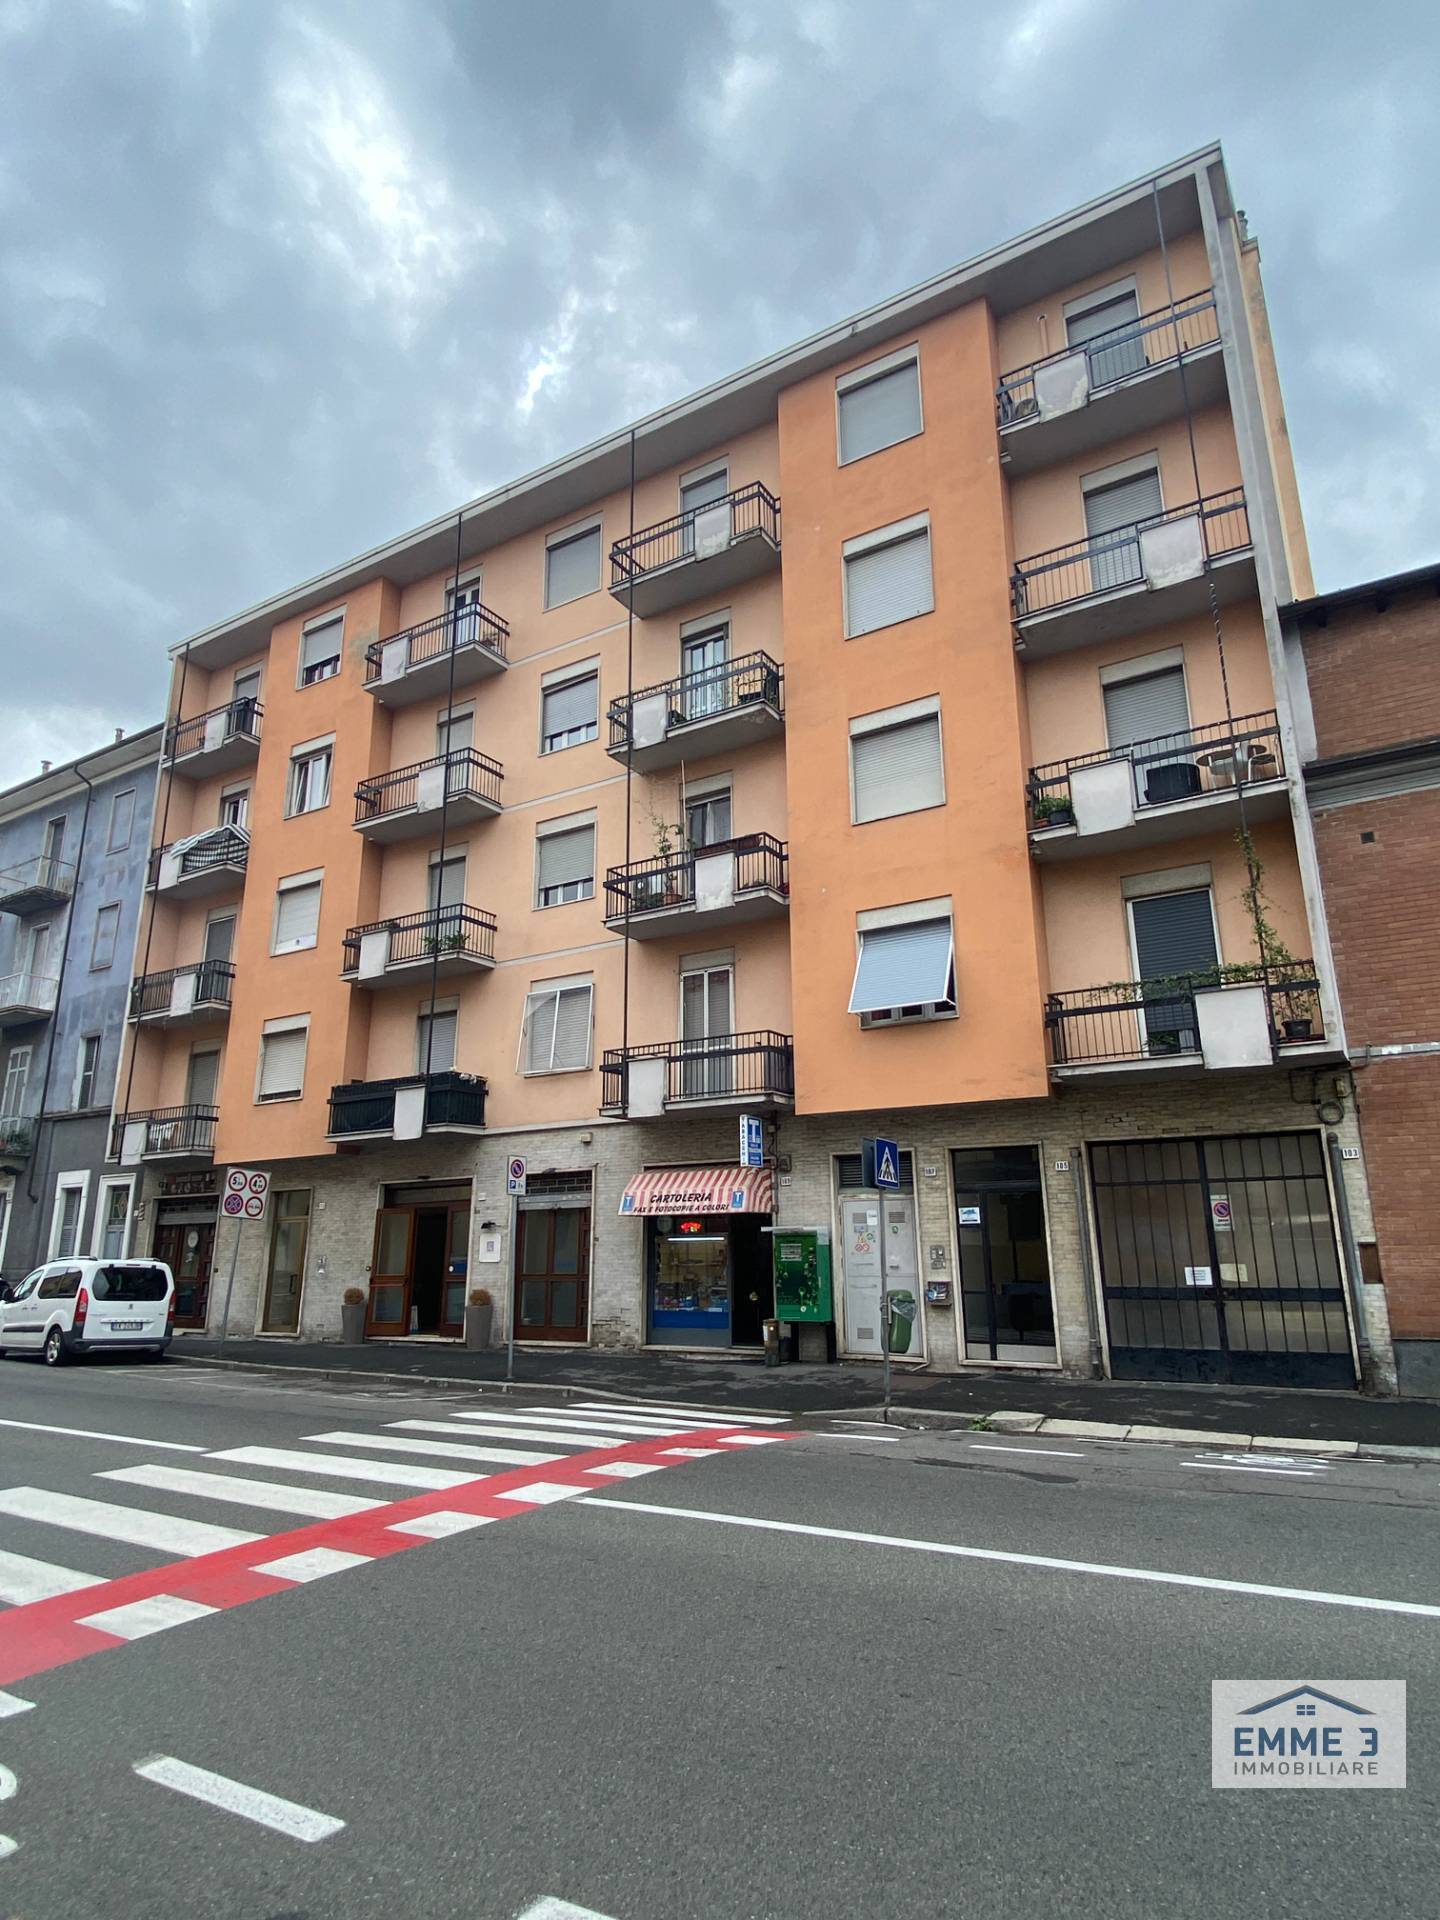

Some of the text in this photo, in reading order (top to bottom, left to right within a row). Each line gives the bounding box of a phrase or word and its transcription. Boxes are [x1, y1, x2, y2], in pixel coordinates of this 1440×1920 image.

[1344, 1149, 1357, 1157] 103
[650, 1192, 712, 1204] CARTOLERIA
[655, 1205, 693, 1213] FOTOCOPIE
[702, 1203, 729, 1211] COLORI
